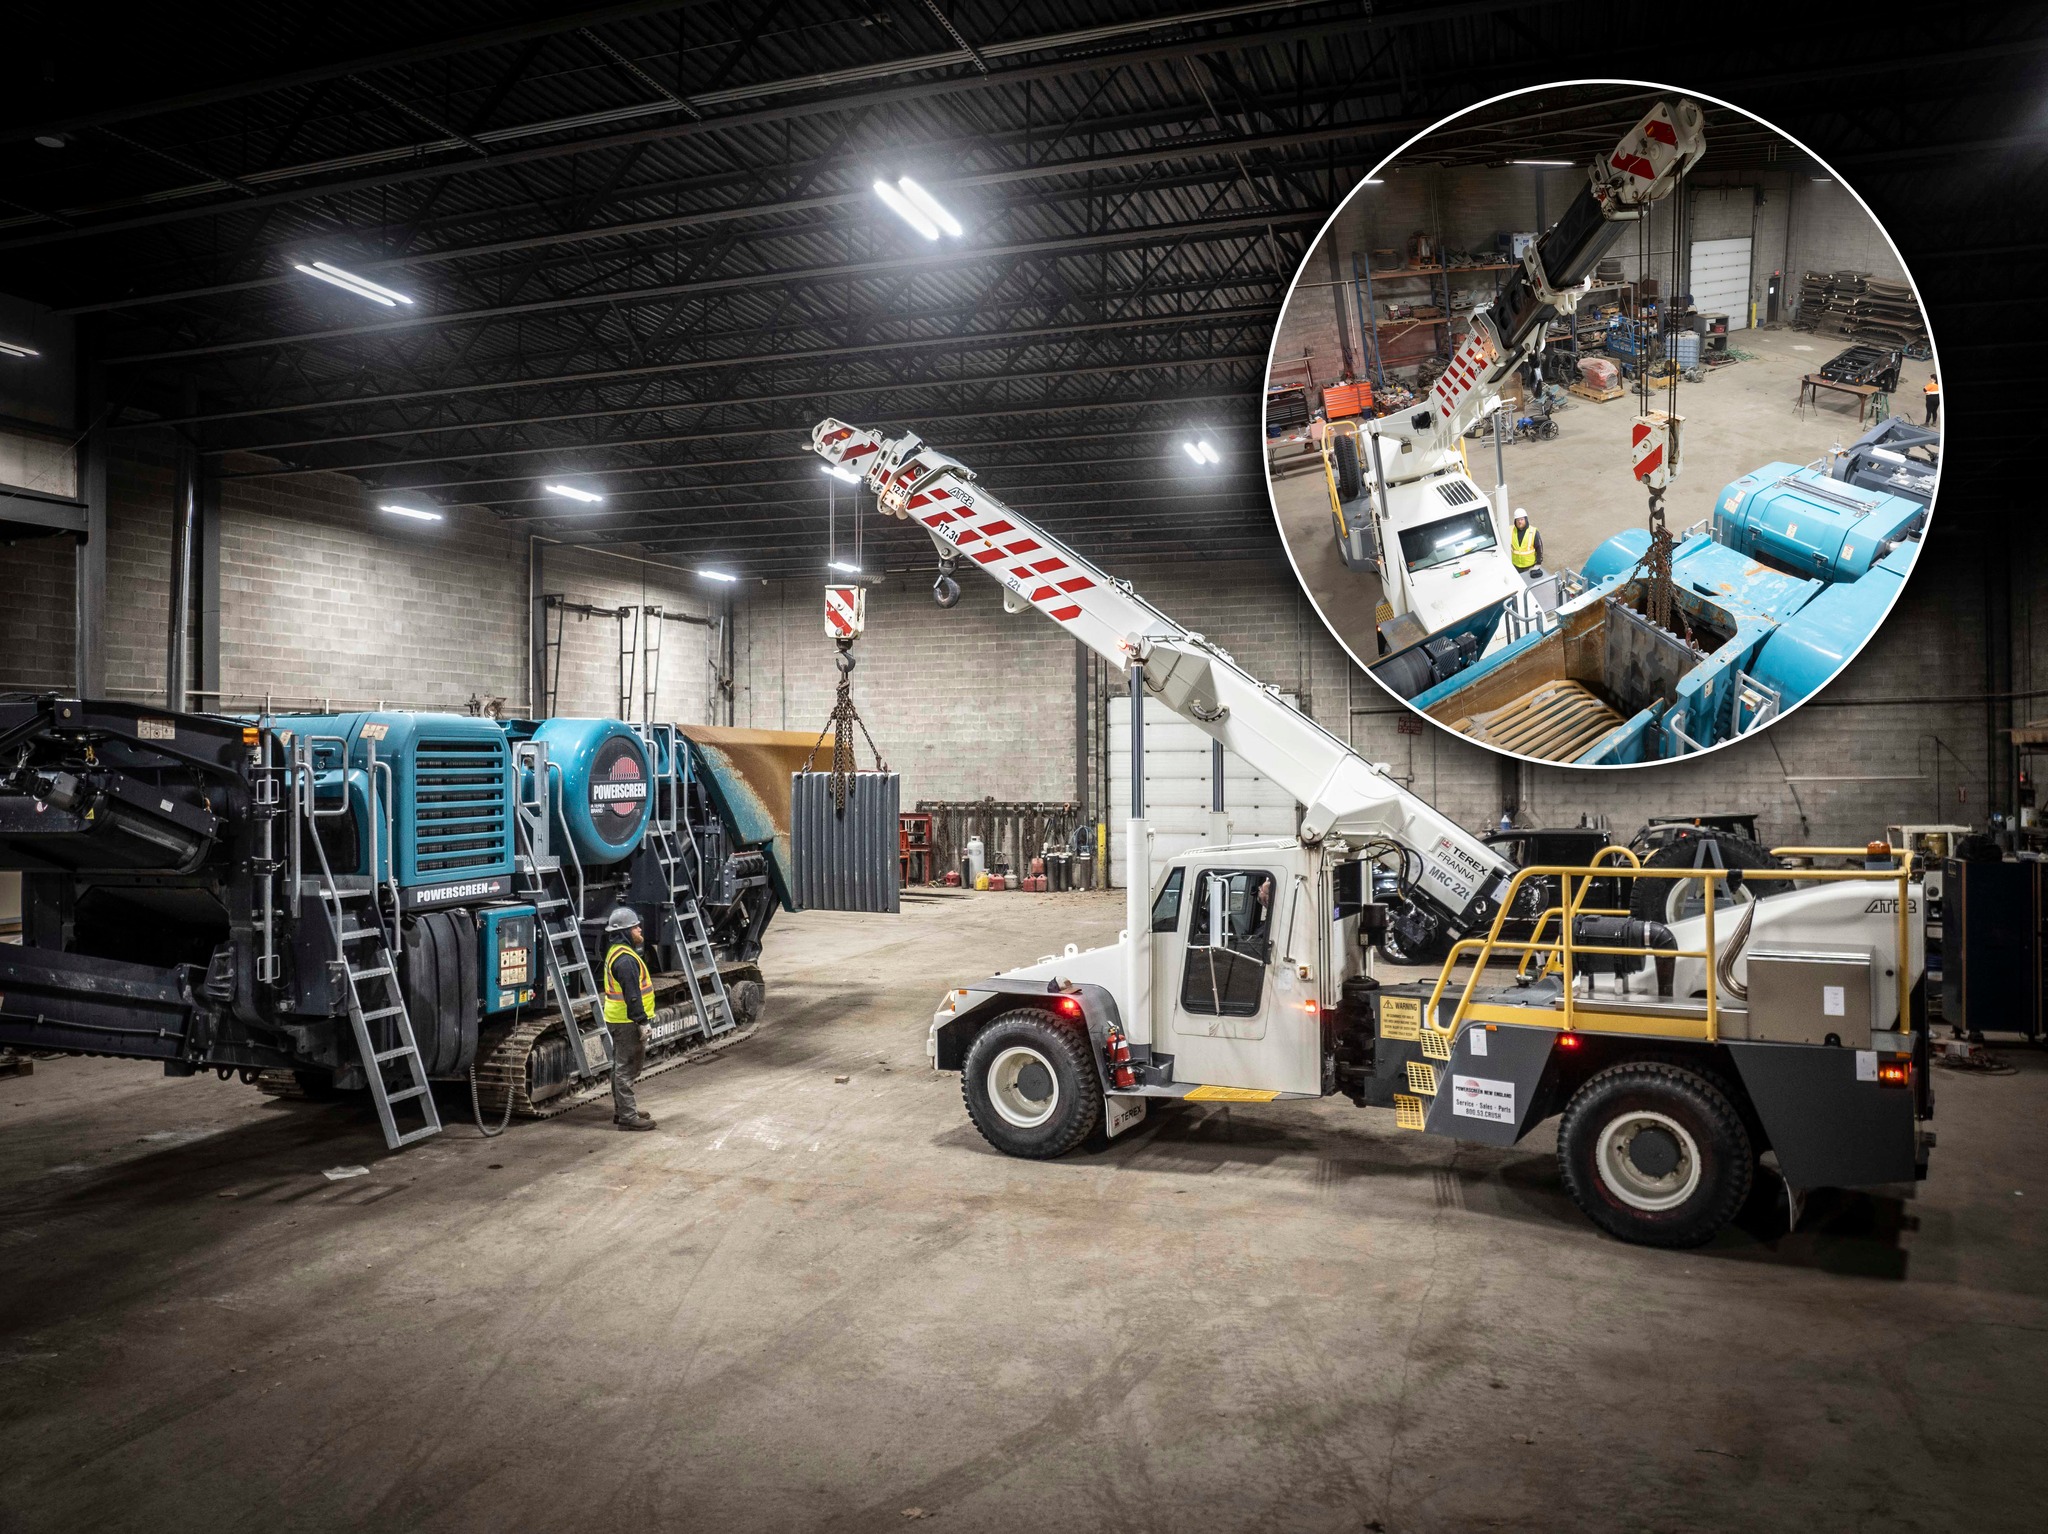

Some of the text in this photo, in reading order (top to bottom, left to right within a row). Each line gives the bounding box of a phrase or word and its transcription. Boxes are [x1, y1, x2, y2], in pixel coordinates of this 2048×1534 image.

[948, 487, 975, 508] AT22
[939, 522, 959, 543] 17.3t
[1007, 577, 1021, 592] 22t
[593, 783, 647, 800] POWERSCREEN
[1437, 851, 1475, 883] FRANNA
[1453, 846, 1489, 876] TEREX
[417, 882, 488, 903] POWERSCREEN
[1428, 865, 1471, 900] MRC 22t
[1394, 1001, 1418, 1011] WARNING
[1455, 1085, 1484, 1095] POWERSCREEN
[1493, 1091, 1513, 1099] ENGLAND
[1121, 1104, 1142, 1123] TEREX
[1456, 1098, 1512, 1114] Service Sales Parts
